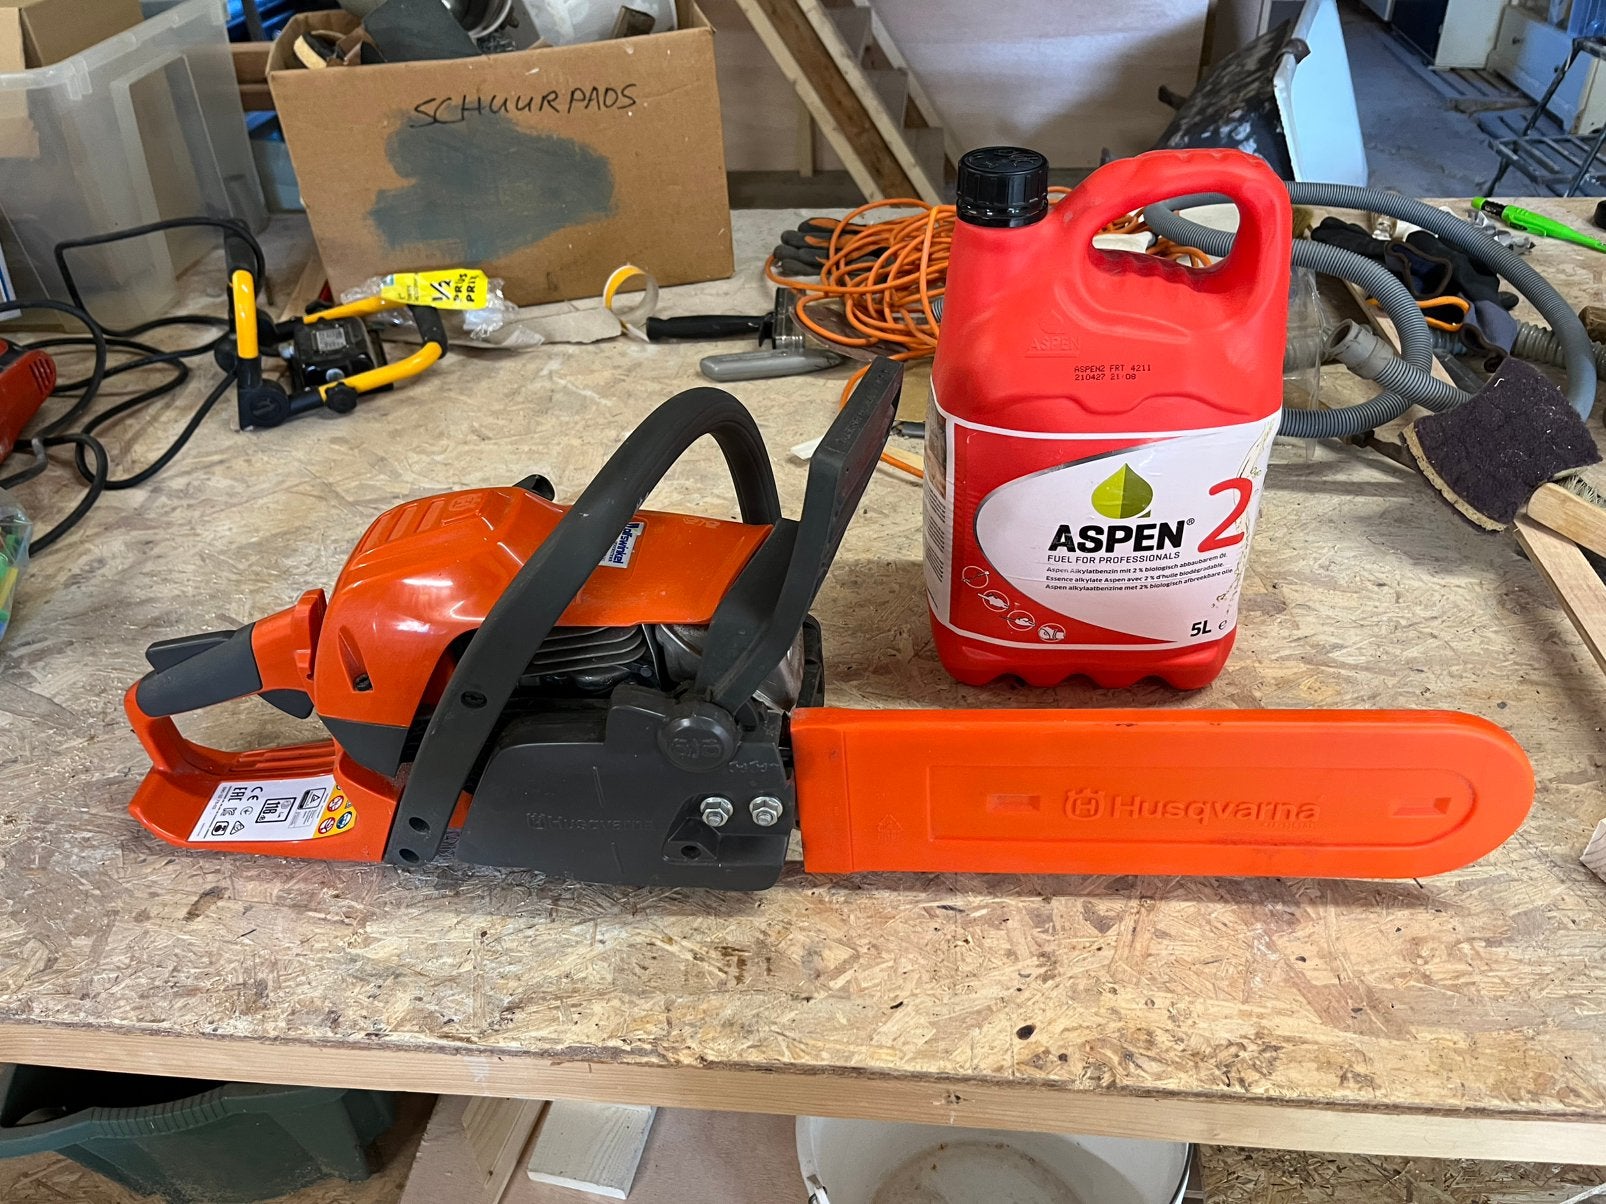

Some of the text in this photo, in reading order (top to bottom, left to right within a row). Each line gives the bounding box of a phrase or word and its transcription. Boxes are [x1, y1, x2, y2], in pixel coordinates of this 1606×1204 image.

[430, 279, 453, 302] 1/2
[1074, 364, 1151, 373] ASPEN2 FRT 4211
[1048, 477, 1253, 553] ASPEN 2
[1047, 551, 1180, 564] FUEL FOR PROFESSIONALS
[1144, 564, 1178, 572] biologisch
[1179, 555, 1218, 568] abbaubarem
[1149, 580, 1182, 589] biologisch
[1183, 571, 1221, 584] afbreekbare
[1156, 572, 1178, 580] d'huile
[1190, 619, 1212, 637] 5L
[1111, 795, 1320, 825] Husqvarna
